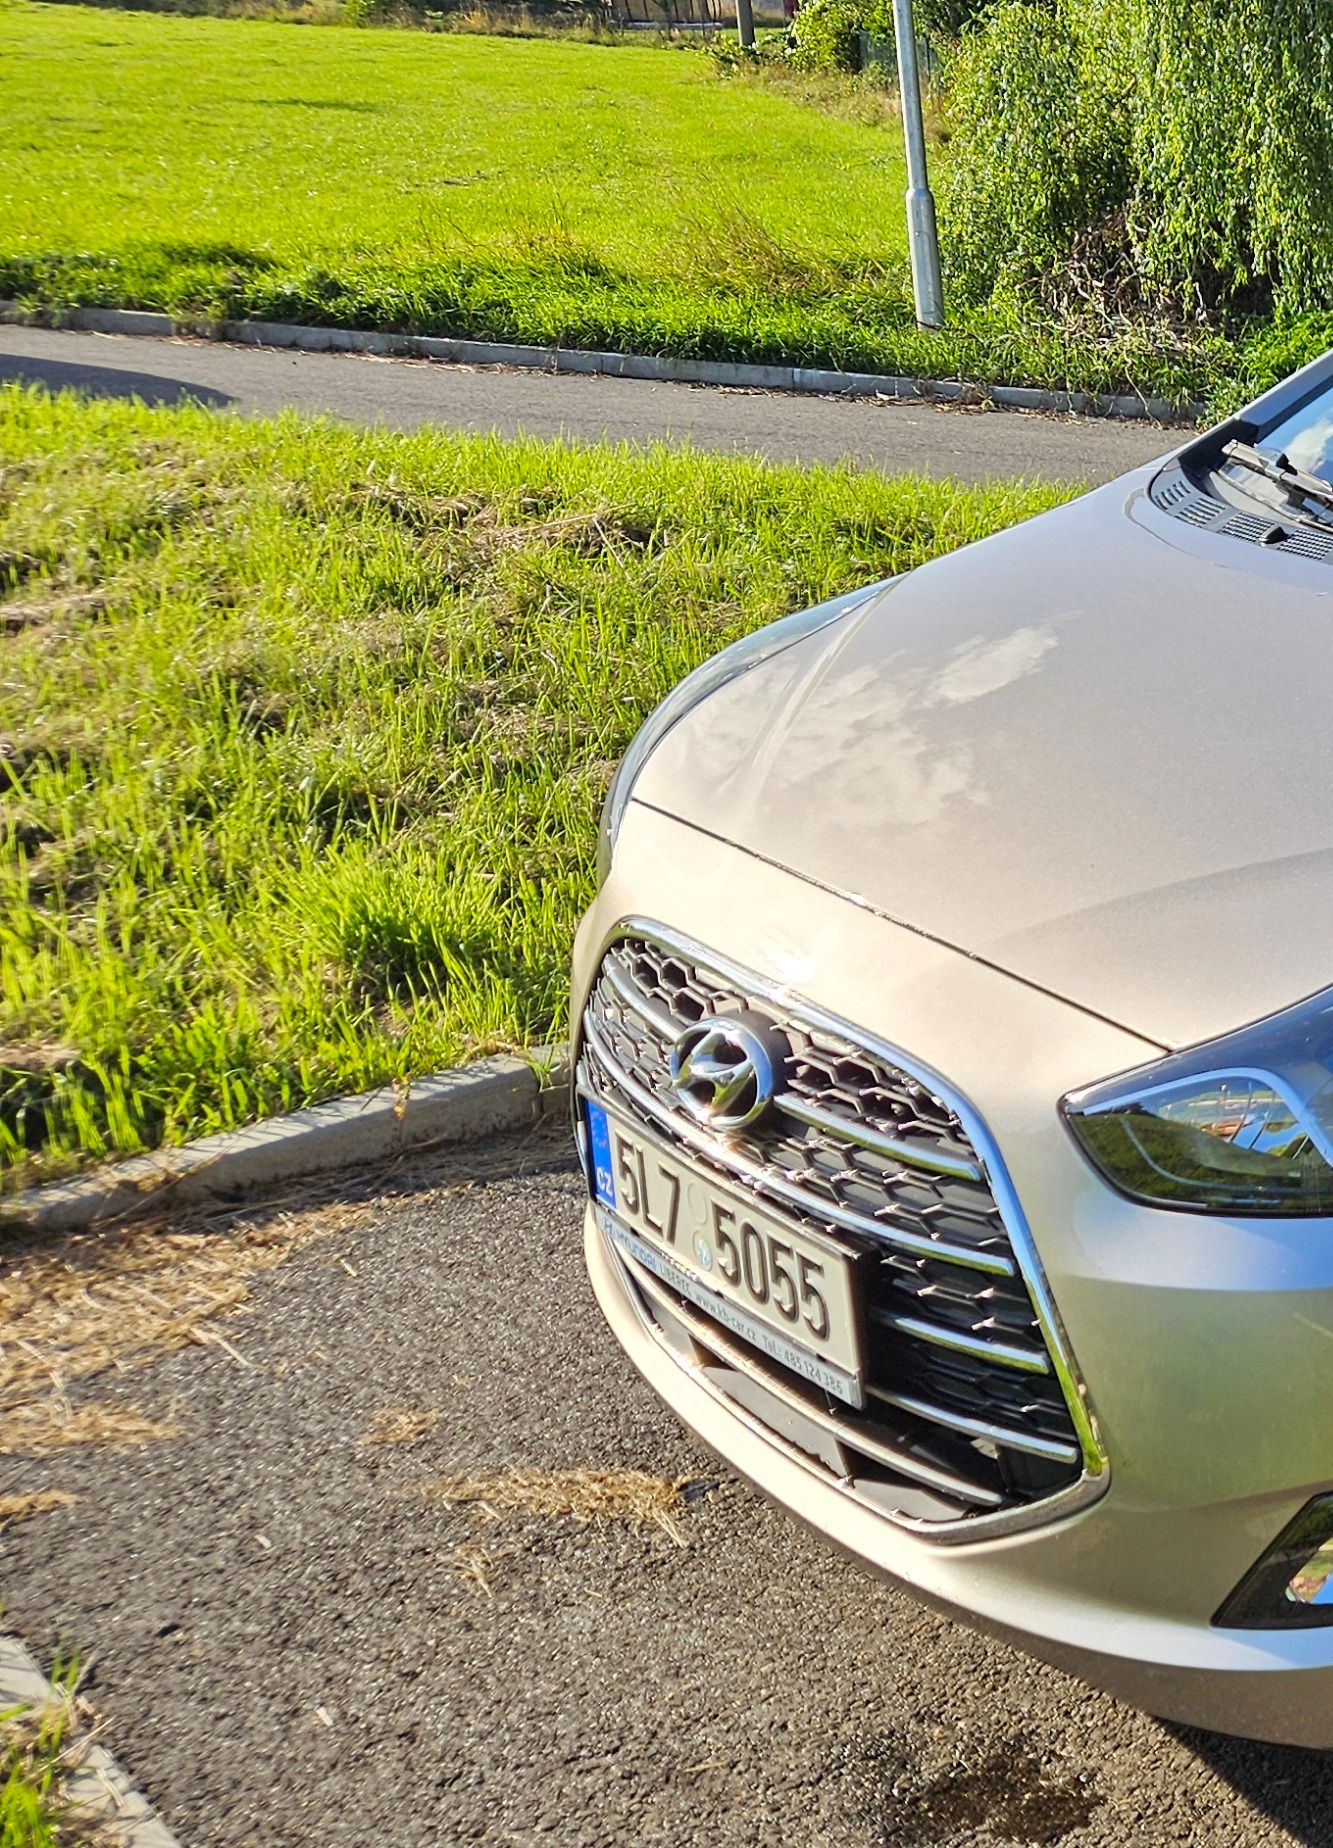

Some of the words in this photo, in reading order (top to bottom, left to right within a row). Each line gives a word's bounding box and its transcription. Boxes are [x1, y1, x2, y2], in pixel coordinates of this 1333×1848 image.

[596, 1168, 613, 1195] CZ
[616, 1131, 681, 1246] 5L7
[711, 1199, 830, 1341] 5055
[660, 1263, 692, 1297] LIBEREC
[784, 1349, 802, 1370] 485
[803, 1360, 821, 1381] 124
